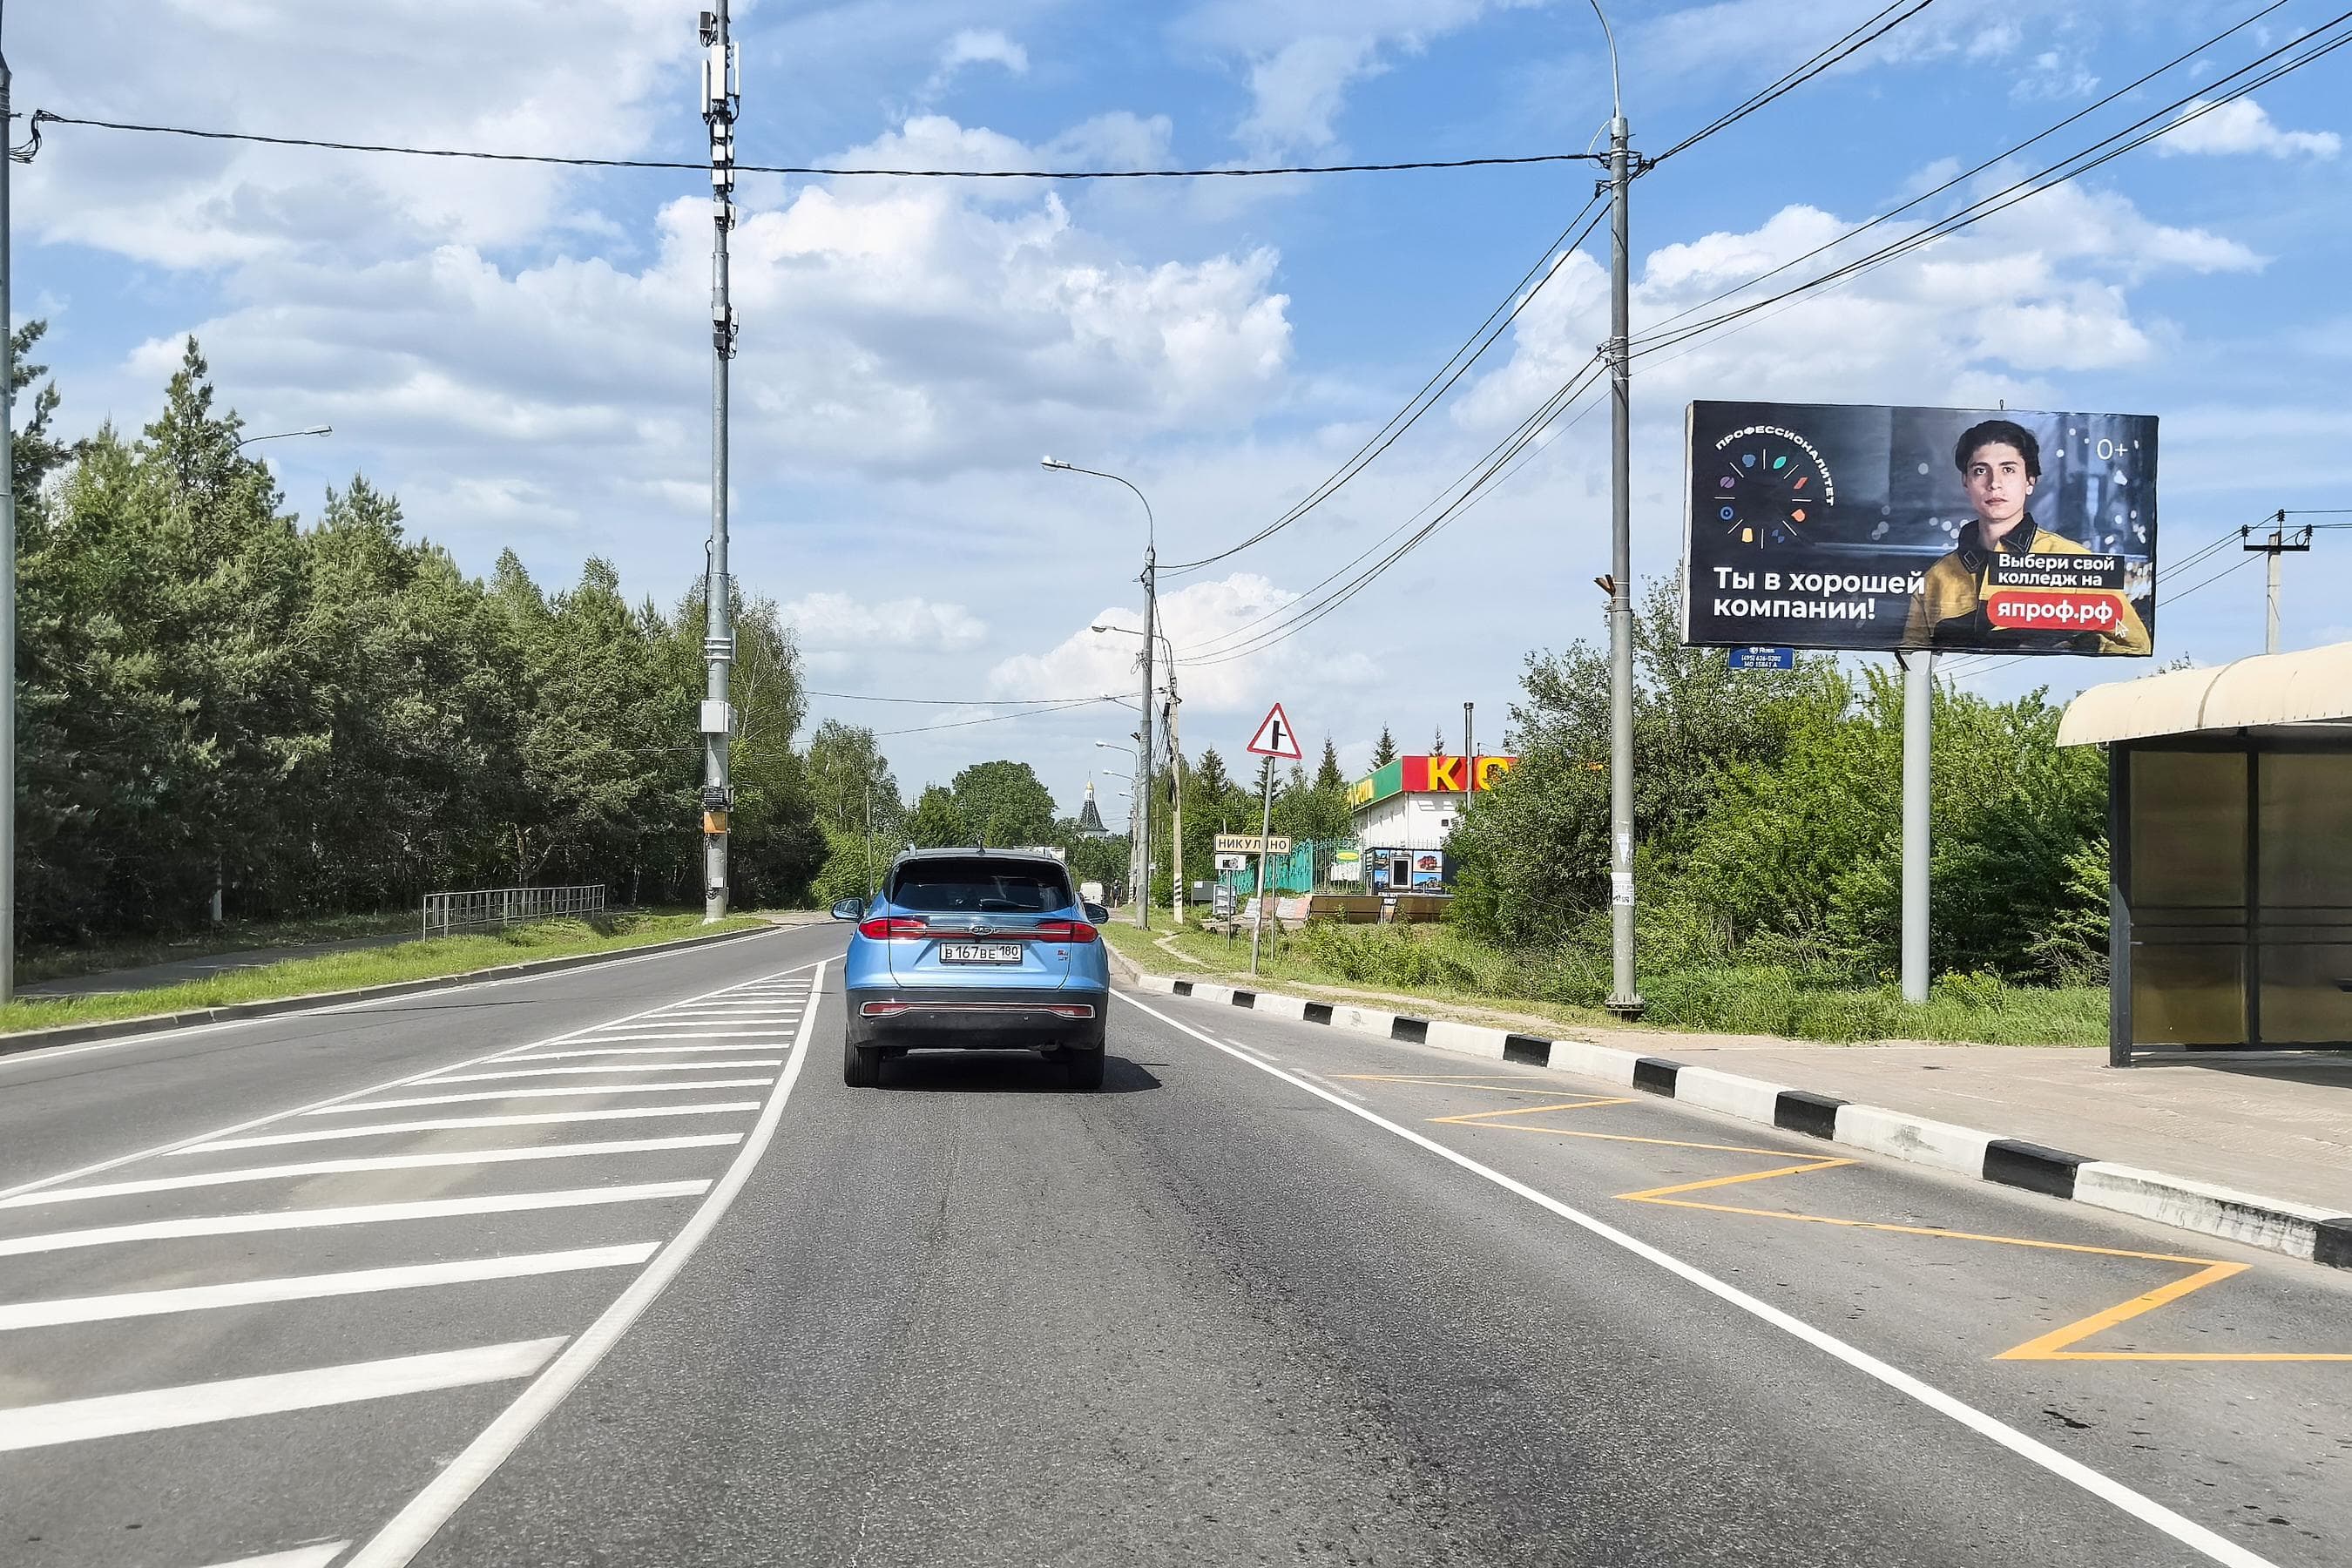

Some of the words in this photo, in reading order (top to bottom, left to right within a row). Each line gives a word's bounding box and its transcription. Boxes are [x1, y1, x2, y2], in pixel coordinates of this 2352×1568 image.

[2097, 438, 2128, 460] 0+
[1715, 425, 1835, 506] ПРОФЕССИОНАЛИТЕТ
[1998, 553, 2069, 571] Выбери
[2073, 556, 2115, 571] свой
[1713, 566, 1754, 590] Ты
[1764, 572, 1781, 591] в
[1788, 571, 1926, 598] хорошей
[1998, 571, 2078, 586] колледж
[2082, 575, 2103, 586] на
[1713, 598, 1876, 620] компании!
[1997, 599, 2113, 624] япроф.рф
[1219, 838, 1287, 850] НИКУЛНО
